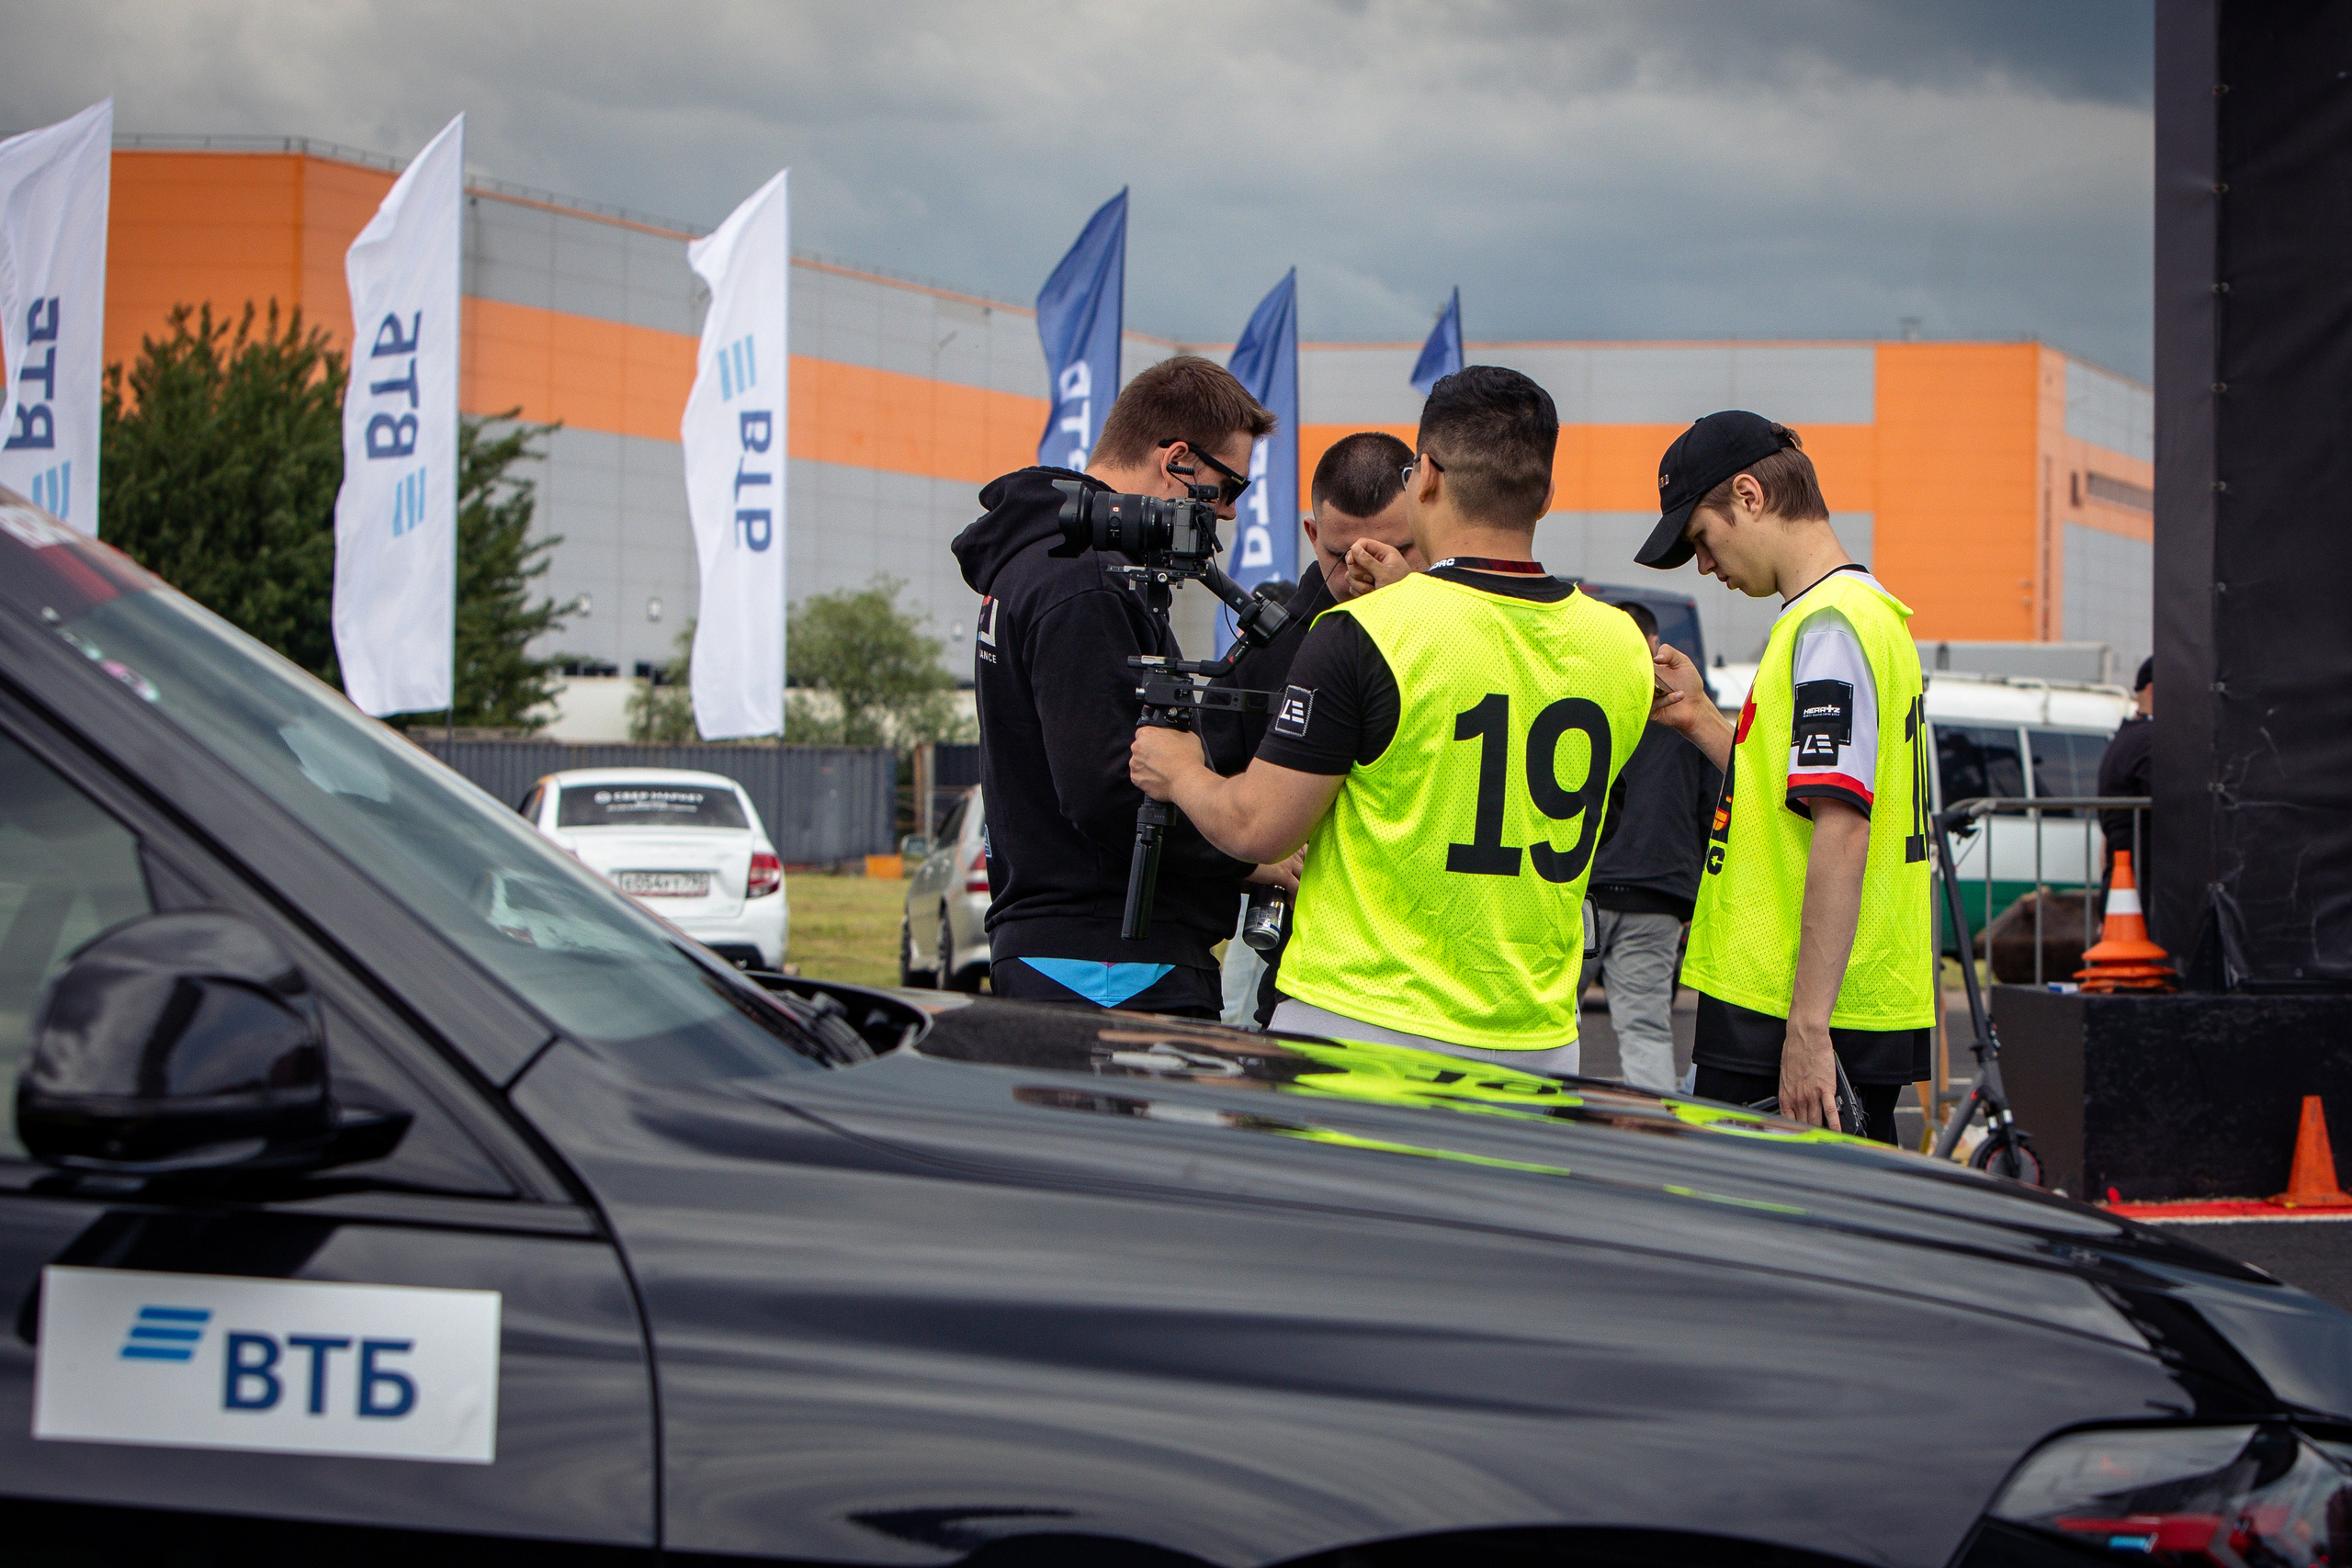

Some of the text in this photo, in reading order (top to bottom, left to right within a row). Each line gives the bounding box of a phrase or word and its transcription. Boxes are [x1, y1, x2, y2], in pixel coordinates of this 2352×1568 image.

[978, 649, 998, 664] ANCE
[1445, 693, 1612, 884] 19
[221, 1330, 419, 1420] ВТБ
